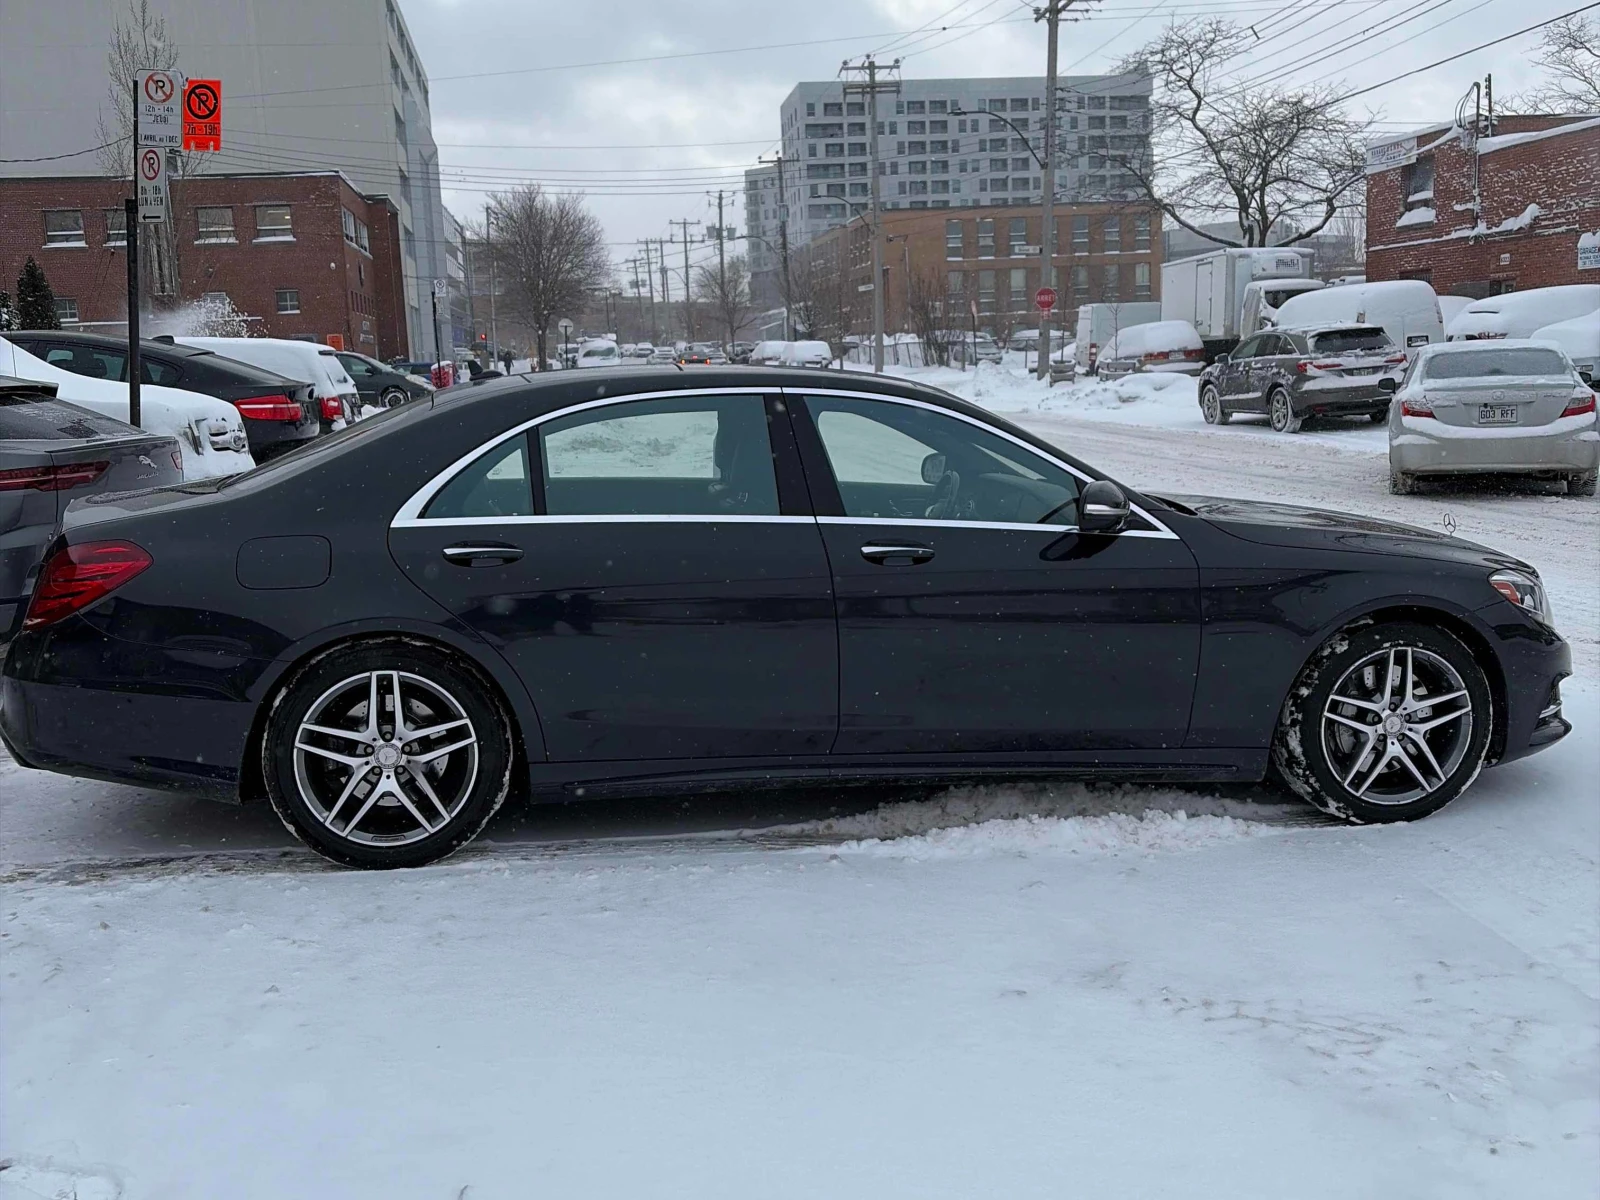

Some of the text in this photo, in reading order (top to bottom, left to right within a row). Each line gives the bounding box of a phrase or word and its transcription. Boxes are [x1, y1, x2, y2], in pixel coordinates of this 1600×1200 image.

[145, 104, 156, 113] 12h
[163, 105, 174, 113] 14h
[187, 123, 197, 135] 7h
[204, 123, 218, 135] 19h
[144, 134, 158, 143] AVRIL
[1500, 408, 1516, 419] RFF
